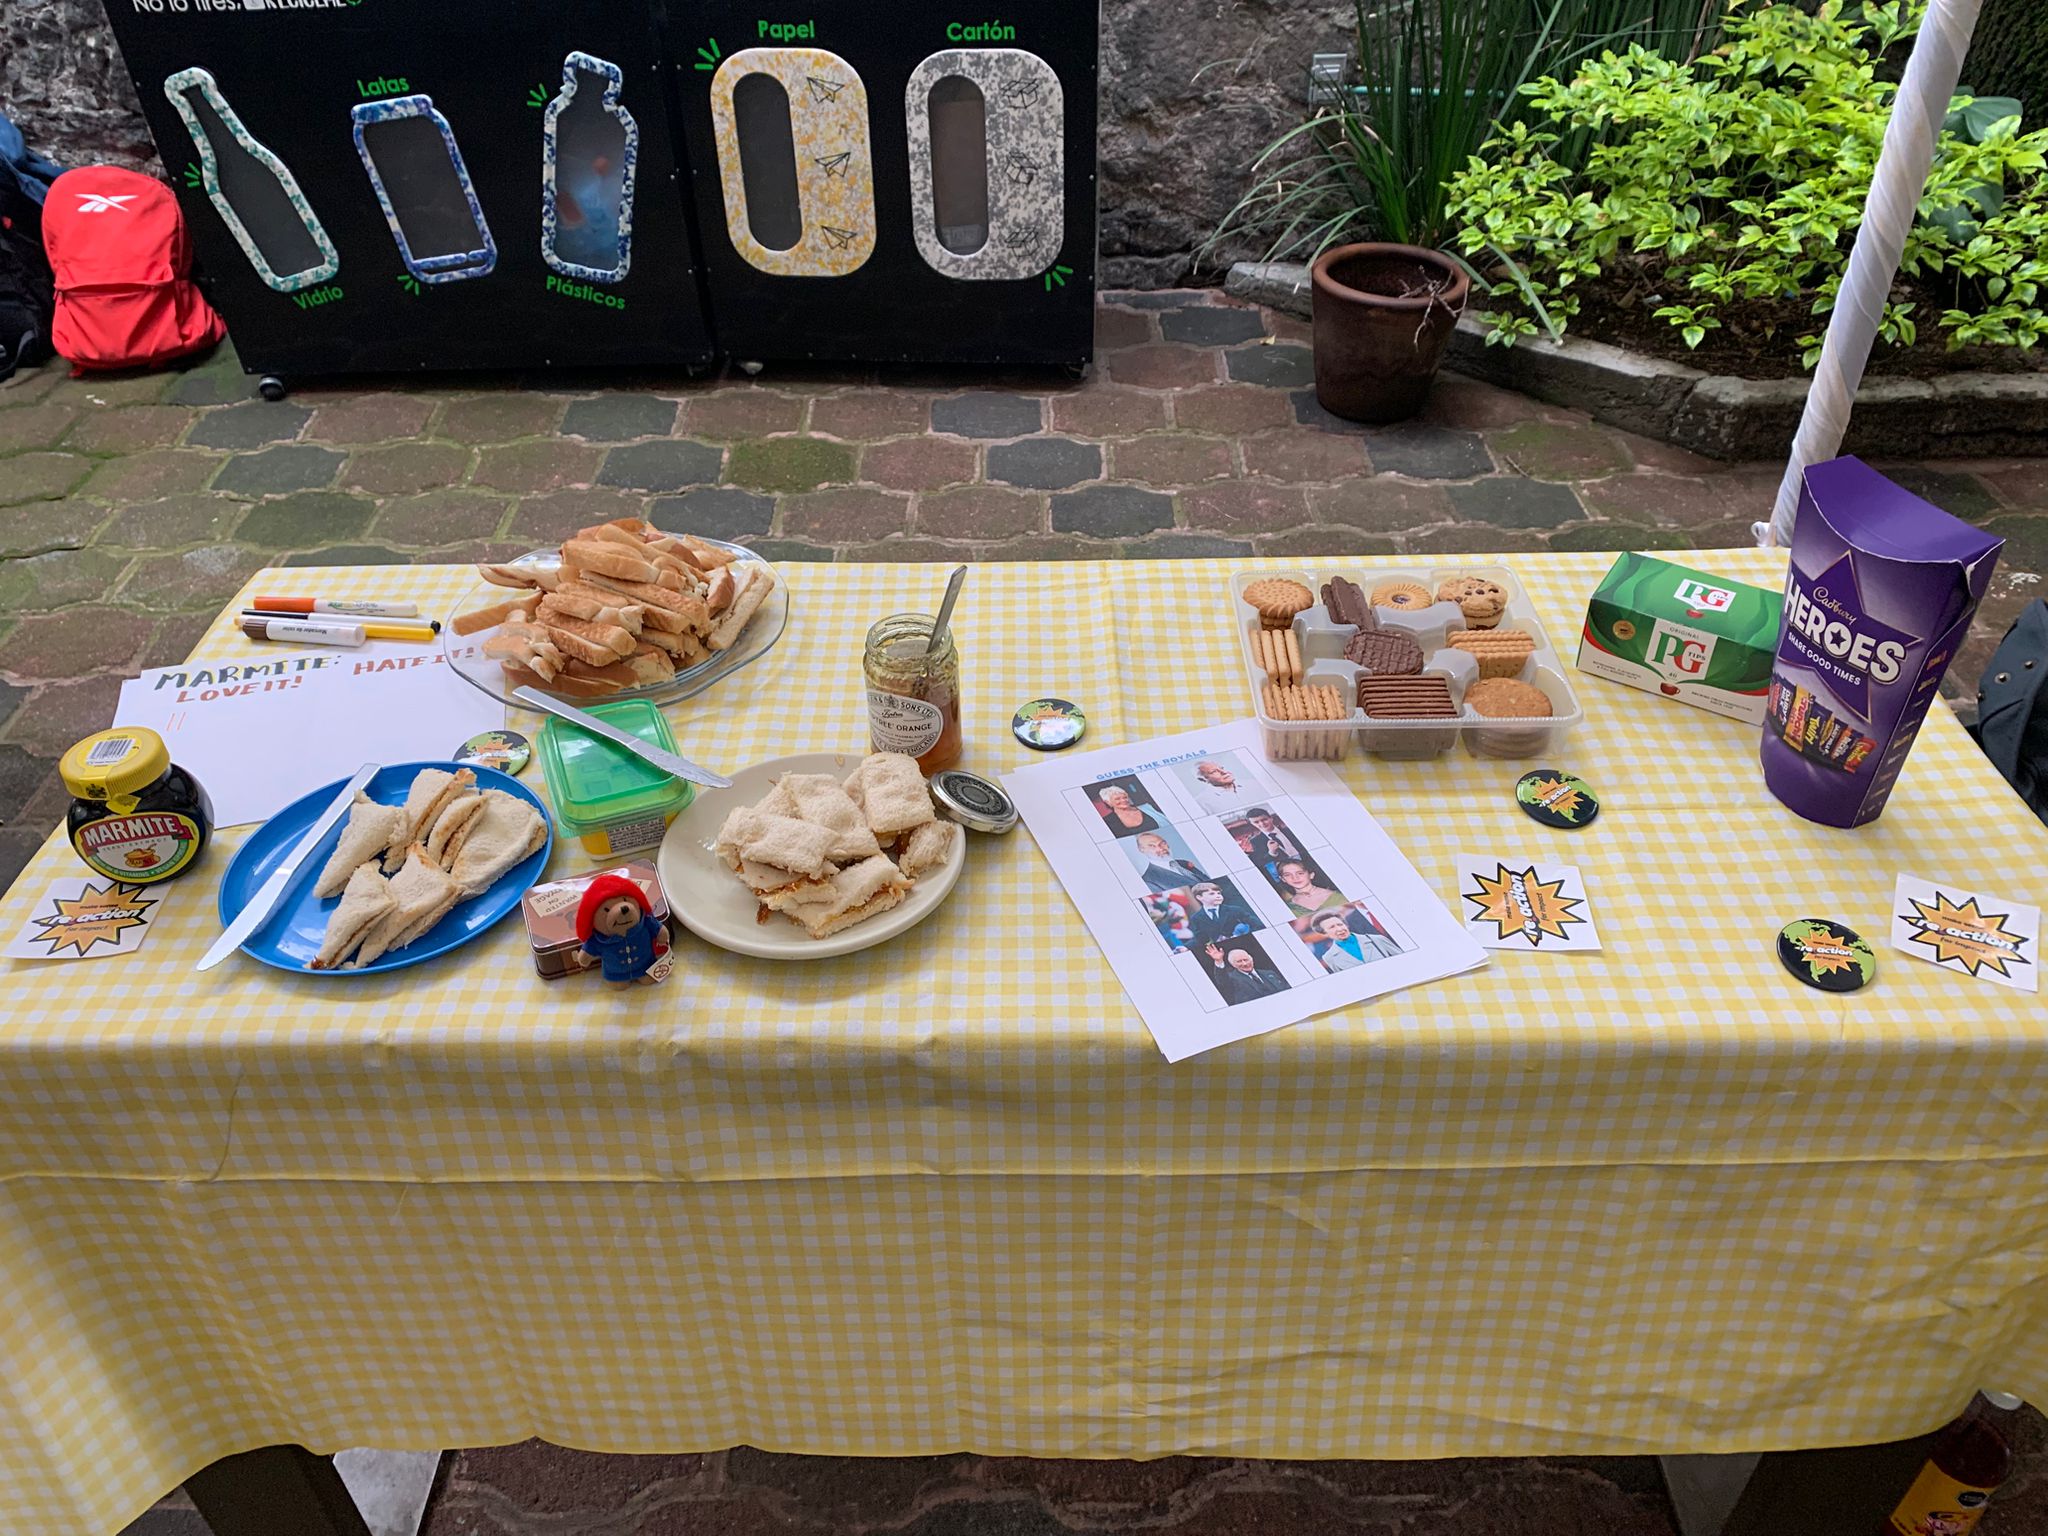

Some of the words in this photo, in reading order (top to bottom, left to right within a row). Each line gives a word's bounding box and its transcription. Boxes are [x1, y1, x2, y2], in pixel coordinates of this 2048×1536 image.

[758, 19, 815, 42] Papel
[946, 19, 1016, 41] Cartón
[357, 76, 410, 97] Latas
[292, 286, 344, 309] Vidrio
[546, 274, 626, 309] Plásticos
[1682, 583, 1728, 606] PG
[1813, 586, 1857, 625] Cadbury
[1669, 626, 1700, 640] ORIGINAL
[1784, 573, 1906, 683] HEROES
[1651, 630, 1706, 673] PG
[1688, 651, 1706, 660] TIPS
[1788, 632, 1806, 654] SHARE
[1807, 649, 1831, 670] GOOD
[1833, 666, 1862, 686] TIMES
[353, 656, 427, 675] HATE
[176, 681, 260, 703] LOVE
[263, 675, 303, 692] IT!
[900, 701, 921, 713] SONS
[896, 723, 933, 732] ORANGE
[1096, 767, 1135, 780] GUESS
[1136, 761, 1160, 771] THE
[1162, 749, 1208, 765] ROYALS
[84, 818, 178, 846] MARMITE
